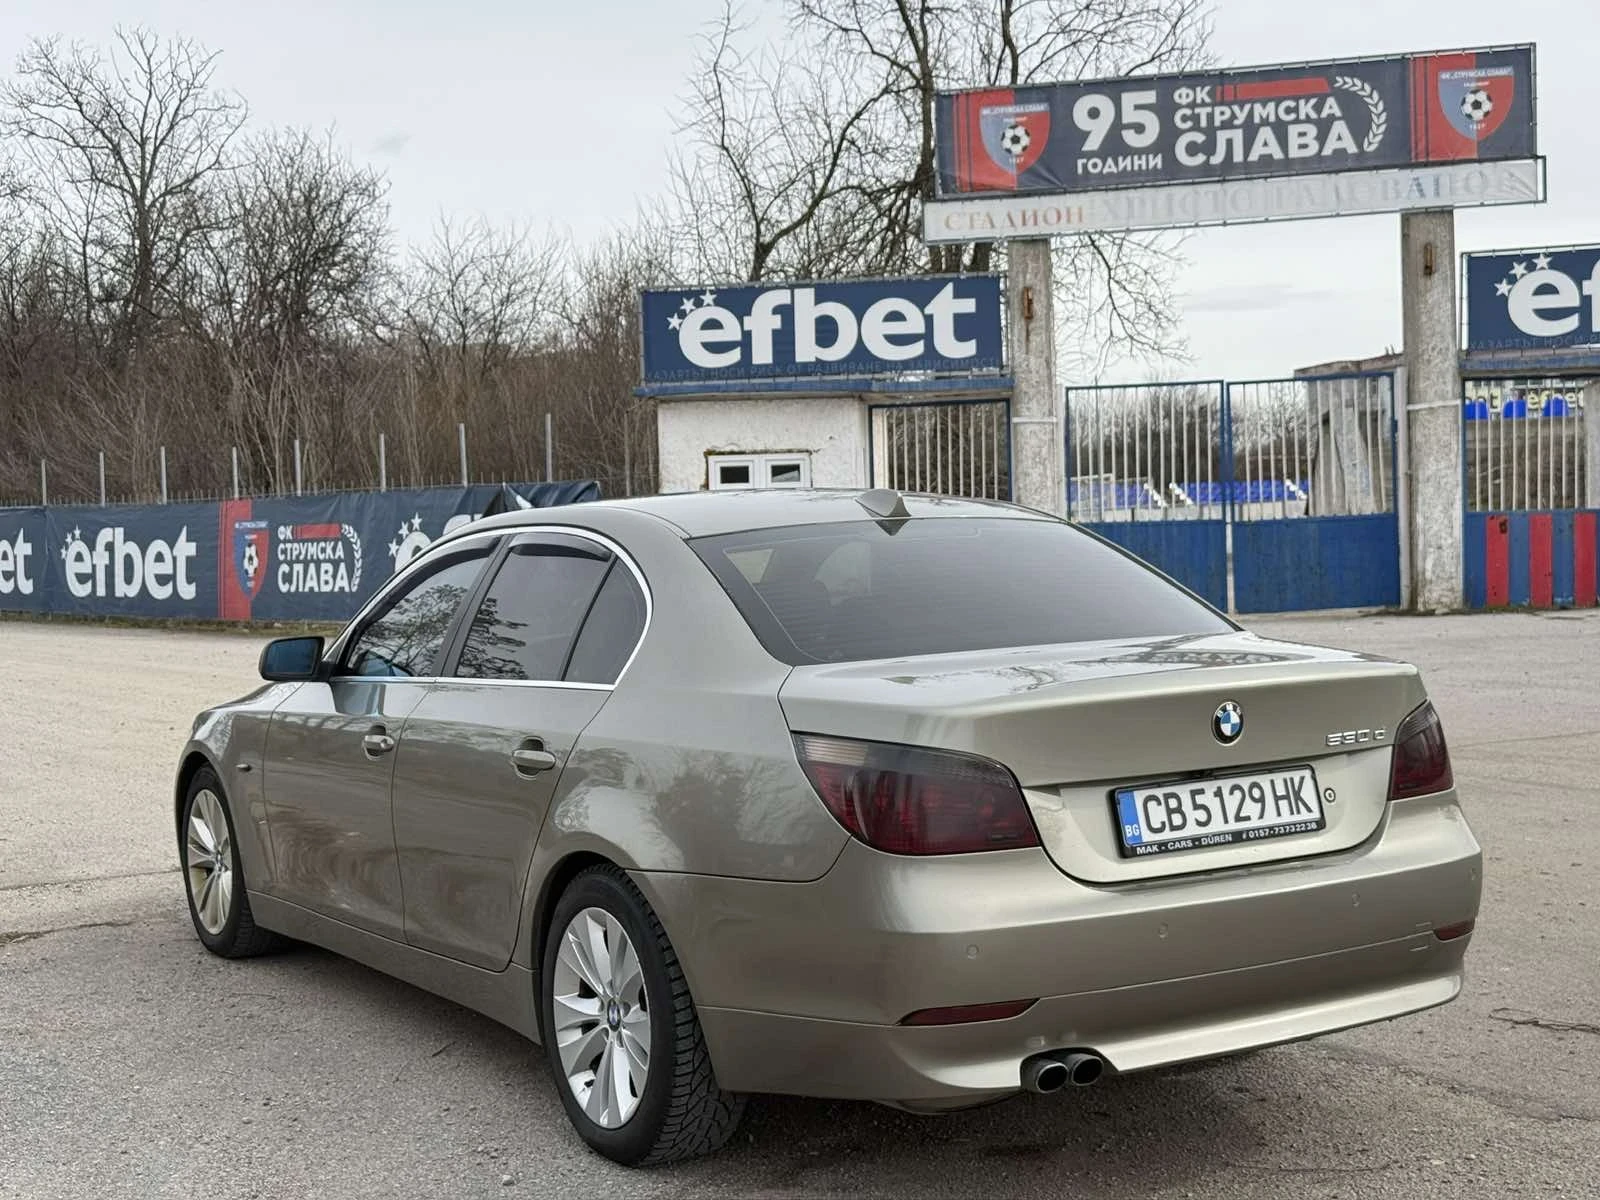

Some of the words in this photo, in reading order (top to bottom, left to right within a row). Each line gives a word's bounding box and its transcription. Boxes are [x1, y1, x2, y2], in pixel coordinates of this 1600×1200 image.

[1173, 85, 1212, 105] ФК
[1073, 90, 1160, 151] 95
[1174, 96, 1342, 129] СТРУМСКА
[1174, 119, 1358, 167] СЛАВА
[1076, 152, 1163, 175] ГОДИНИ
[944, 206, 1084, 231] СТАДИОН
[678, 282, 977, 368] efbet
[277, 525, 293, 540] ФК
[66, 524, 197, 600] efbet
[277, 541, 345, 561] СТРУМСКА
[277, 562, 350, 593] СЛАВА
[1326, 729, 1370, 746] 530
[1142, 791, 1187, 834] CB
[1190, 781, 1266, 828] 5129
[1270, 775, 1313, 817] HK
[1125, 824, 1140, 837] BG
[1136, 844, 1159, 855] MAK
[1167, 838, 1193, 851] CARS
[1201, 833, 1233, 847] DÜREN
